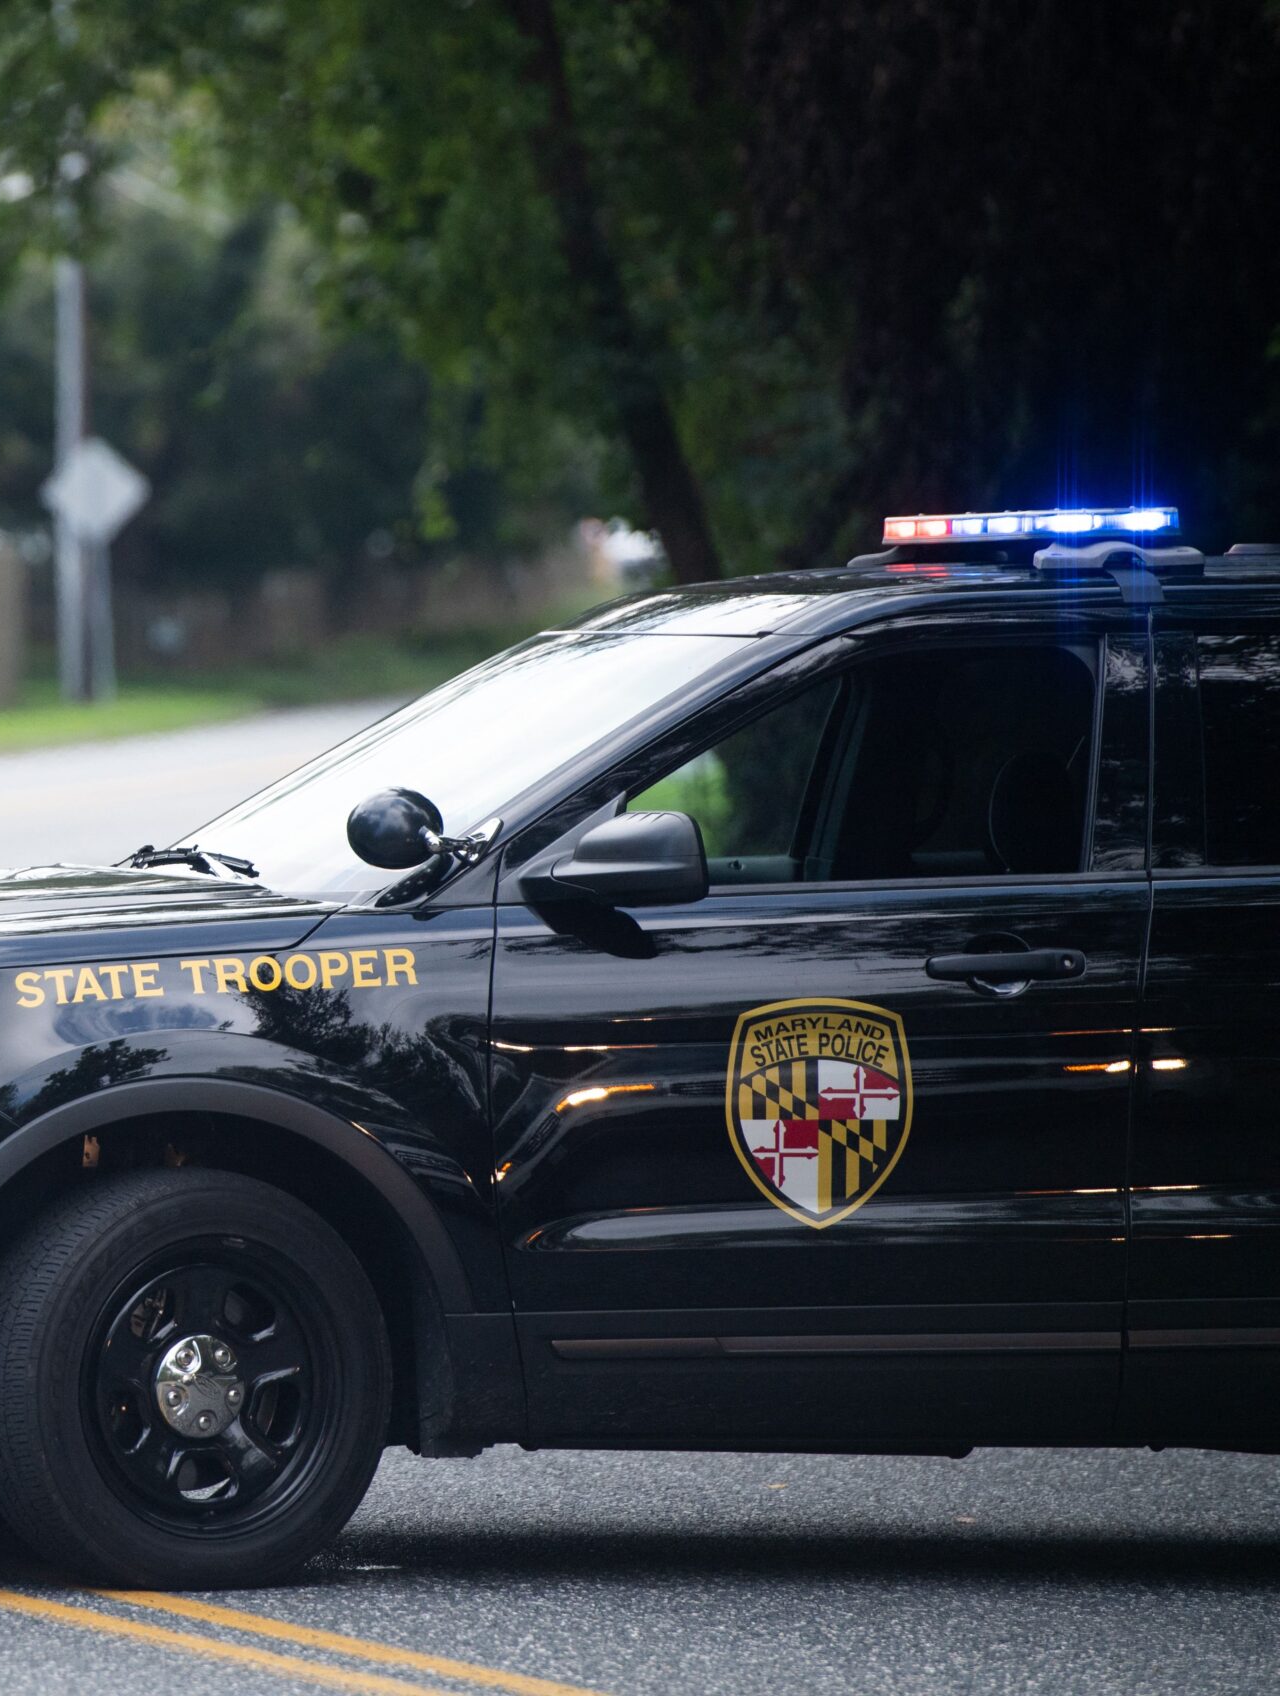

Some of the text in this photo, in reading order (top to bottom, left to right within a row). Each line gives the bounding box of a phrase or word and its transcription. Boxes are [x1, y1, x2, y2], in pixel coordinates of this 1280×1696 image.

[15, 948, 418, 1008] STATE TROOPER
[755, 1017, 885, 1042] MARYLAND
[750, 1033, 889, 1068] STATE POLICE
